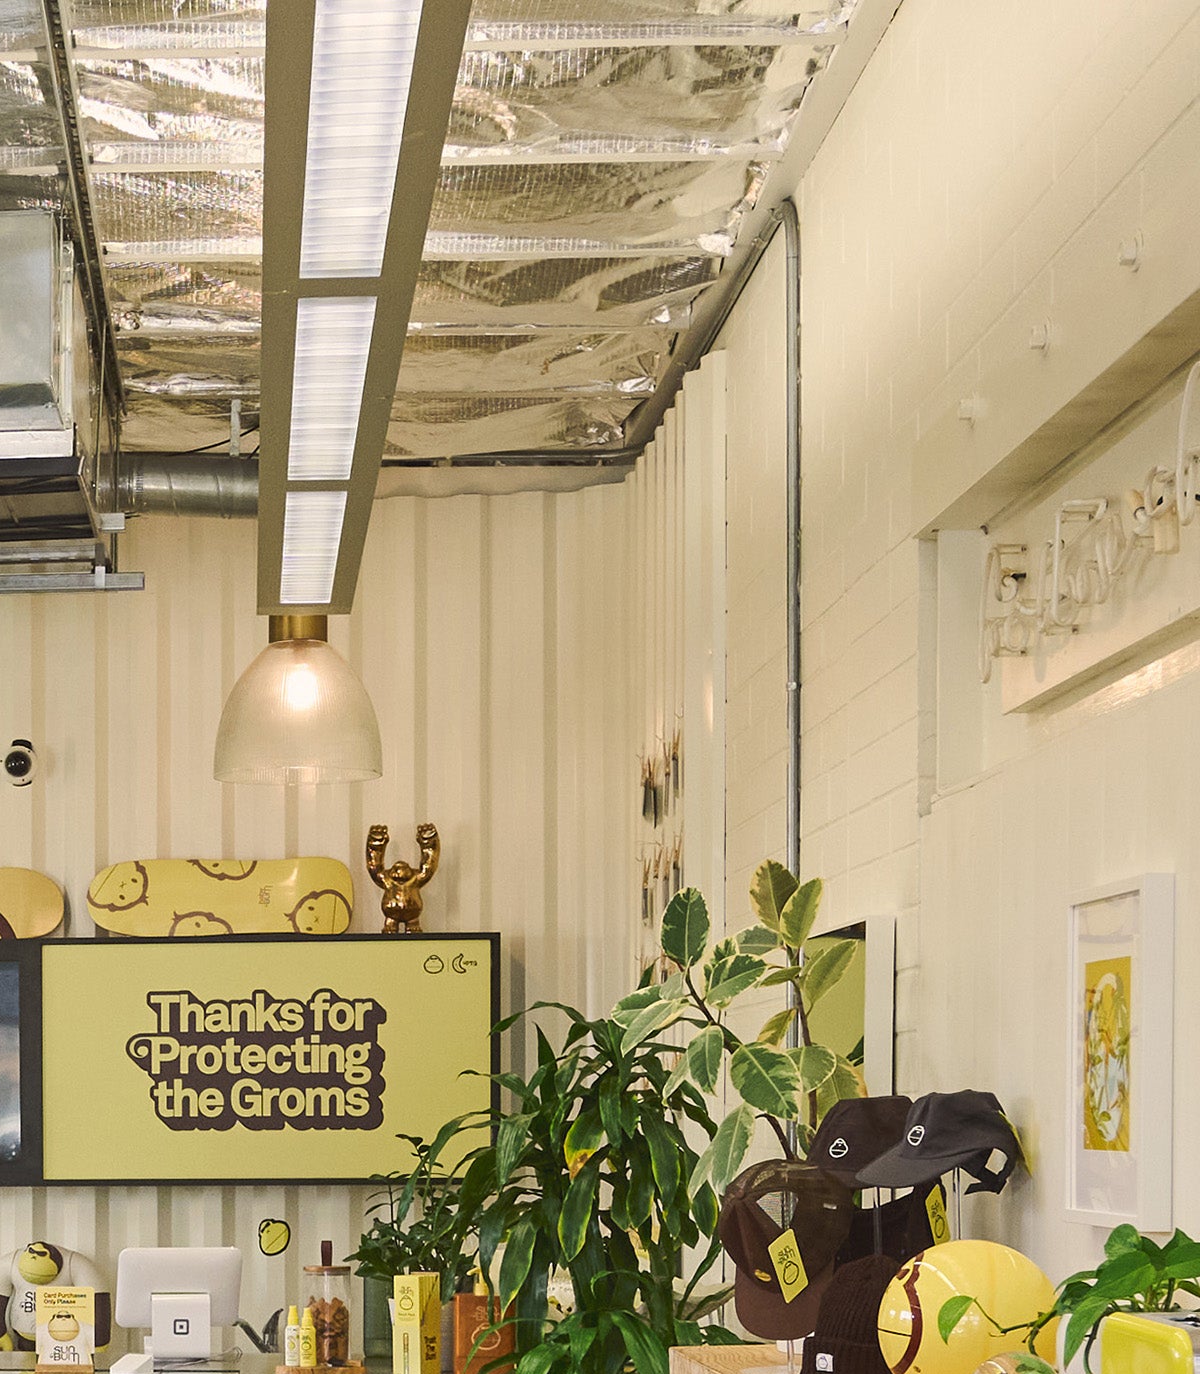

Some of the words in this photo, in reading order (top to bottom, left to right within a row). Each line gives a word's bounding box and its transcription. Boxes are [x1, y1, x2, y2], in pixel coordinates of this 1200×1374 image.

[150, 992, 305, 1033] Thanks
[310, 990, 374, 1032] for
[129, 1034, 372, 1085] Protecting
[153, 1078, 224, 1118] the
[230, 1077, 371, 1118] Groms
